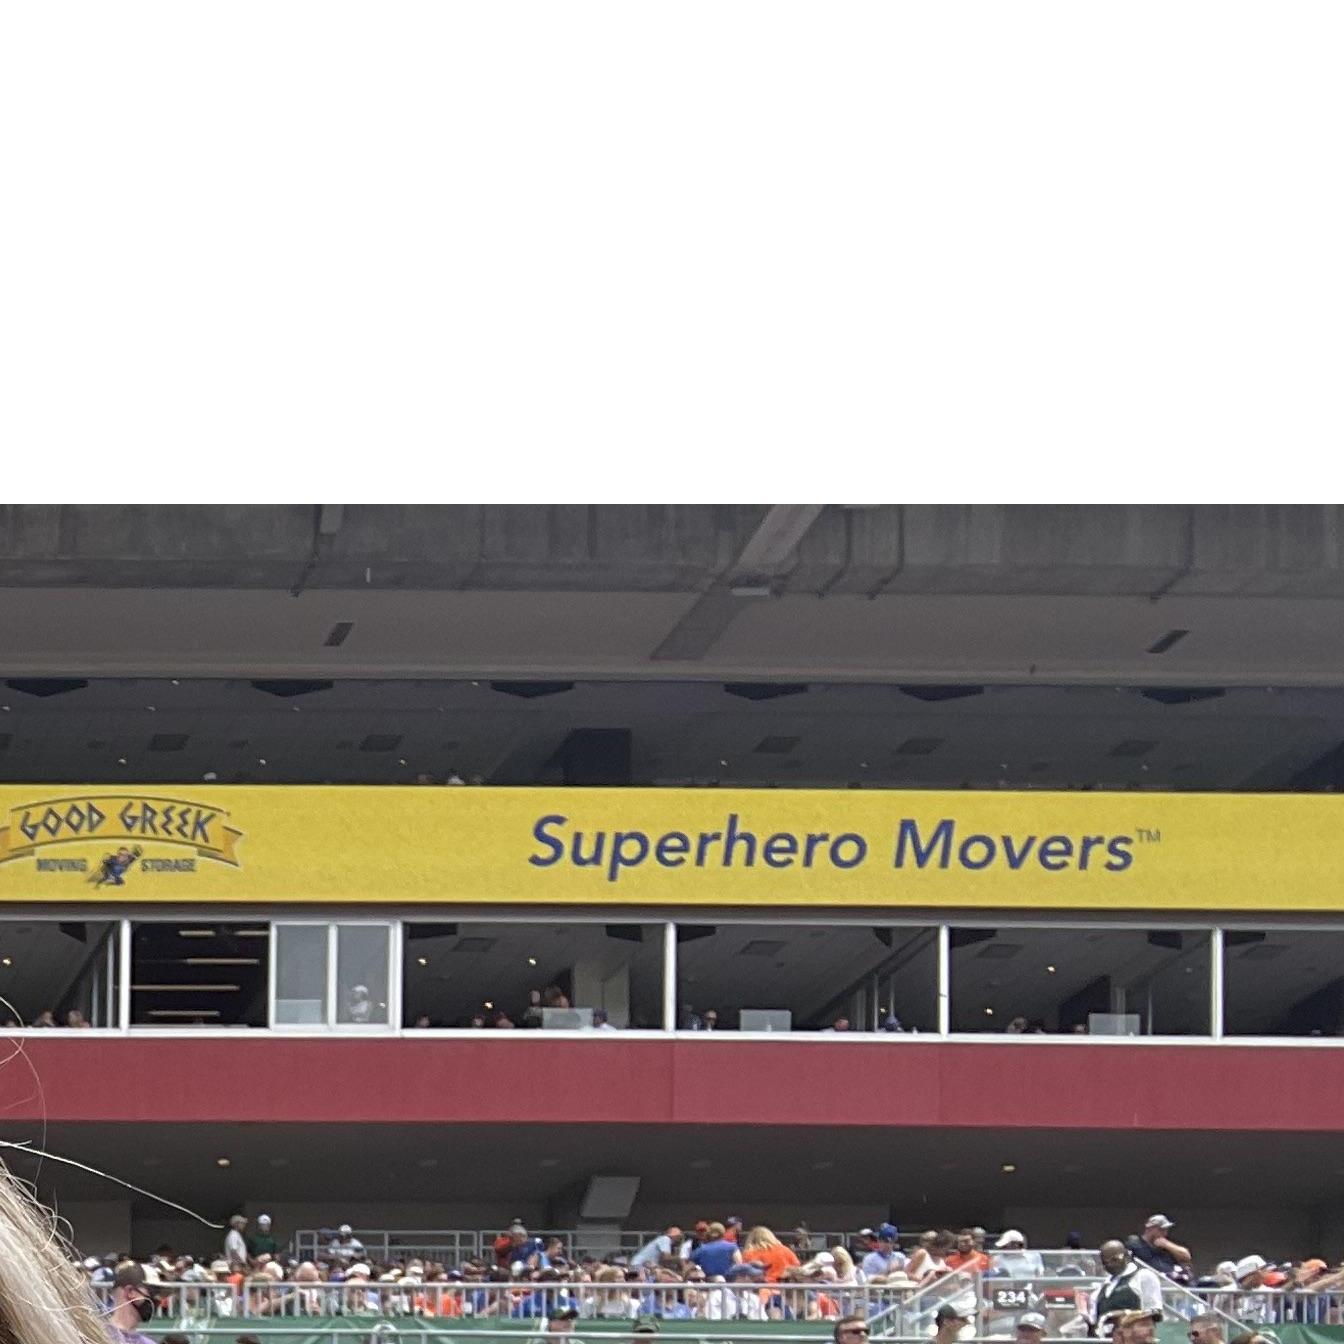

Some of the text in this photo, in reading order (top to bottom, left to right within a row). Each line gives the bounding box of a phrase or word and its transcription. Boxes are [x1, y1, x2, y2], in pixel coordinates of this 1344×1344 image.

[19, 801, 216, 843] GOOD GREEK
[528, 813, 867, 882] Superhero
[893, 818, 1134, 872] Movers
[997, 1290, 1026, 1303] 234
